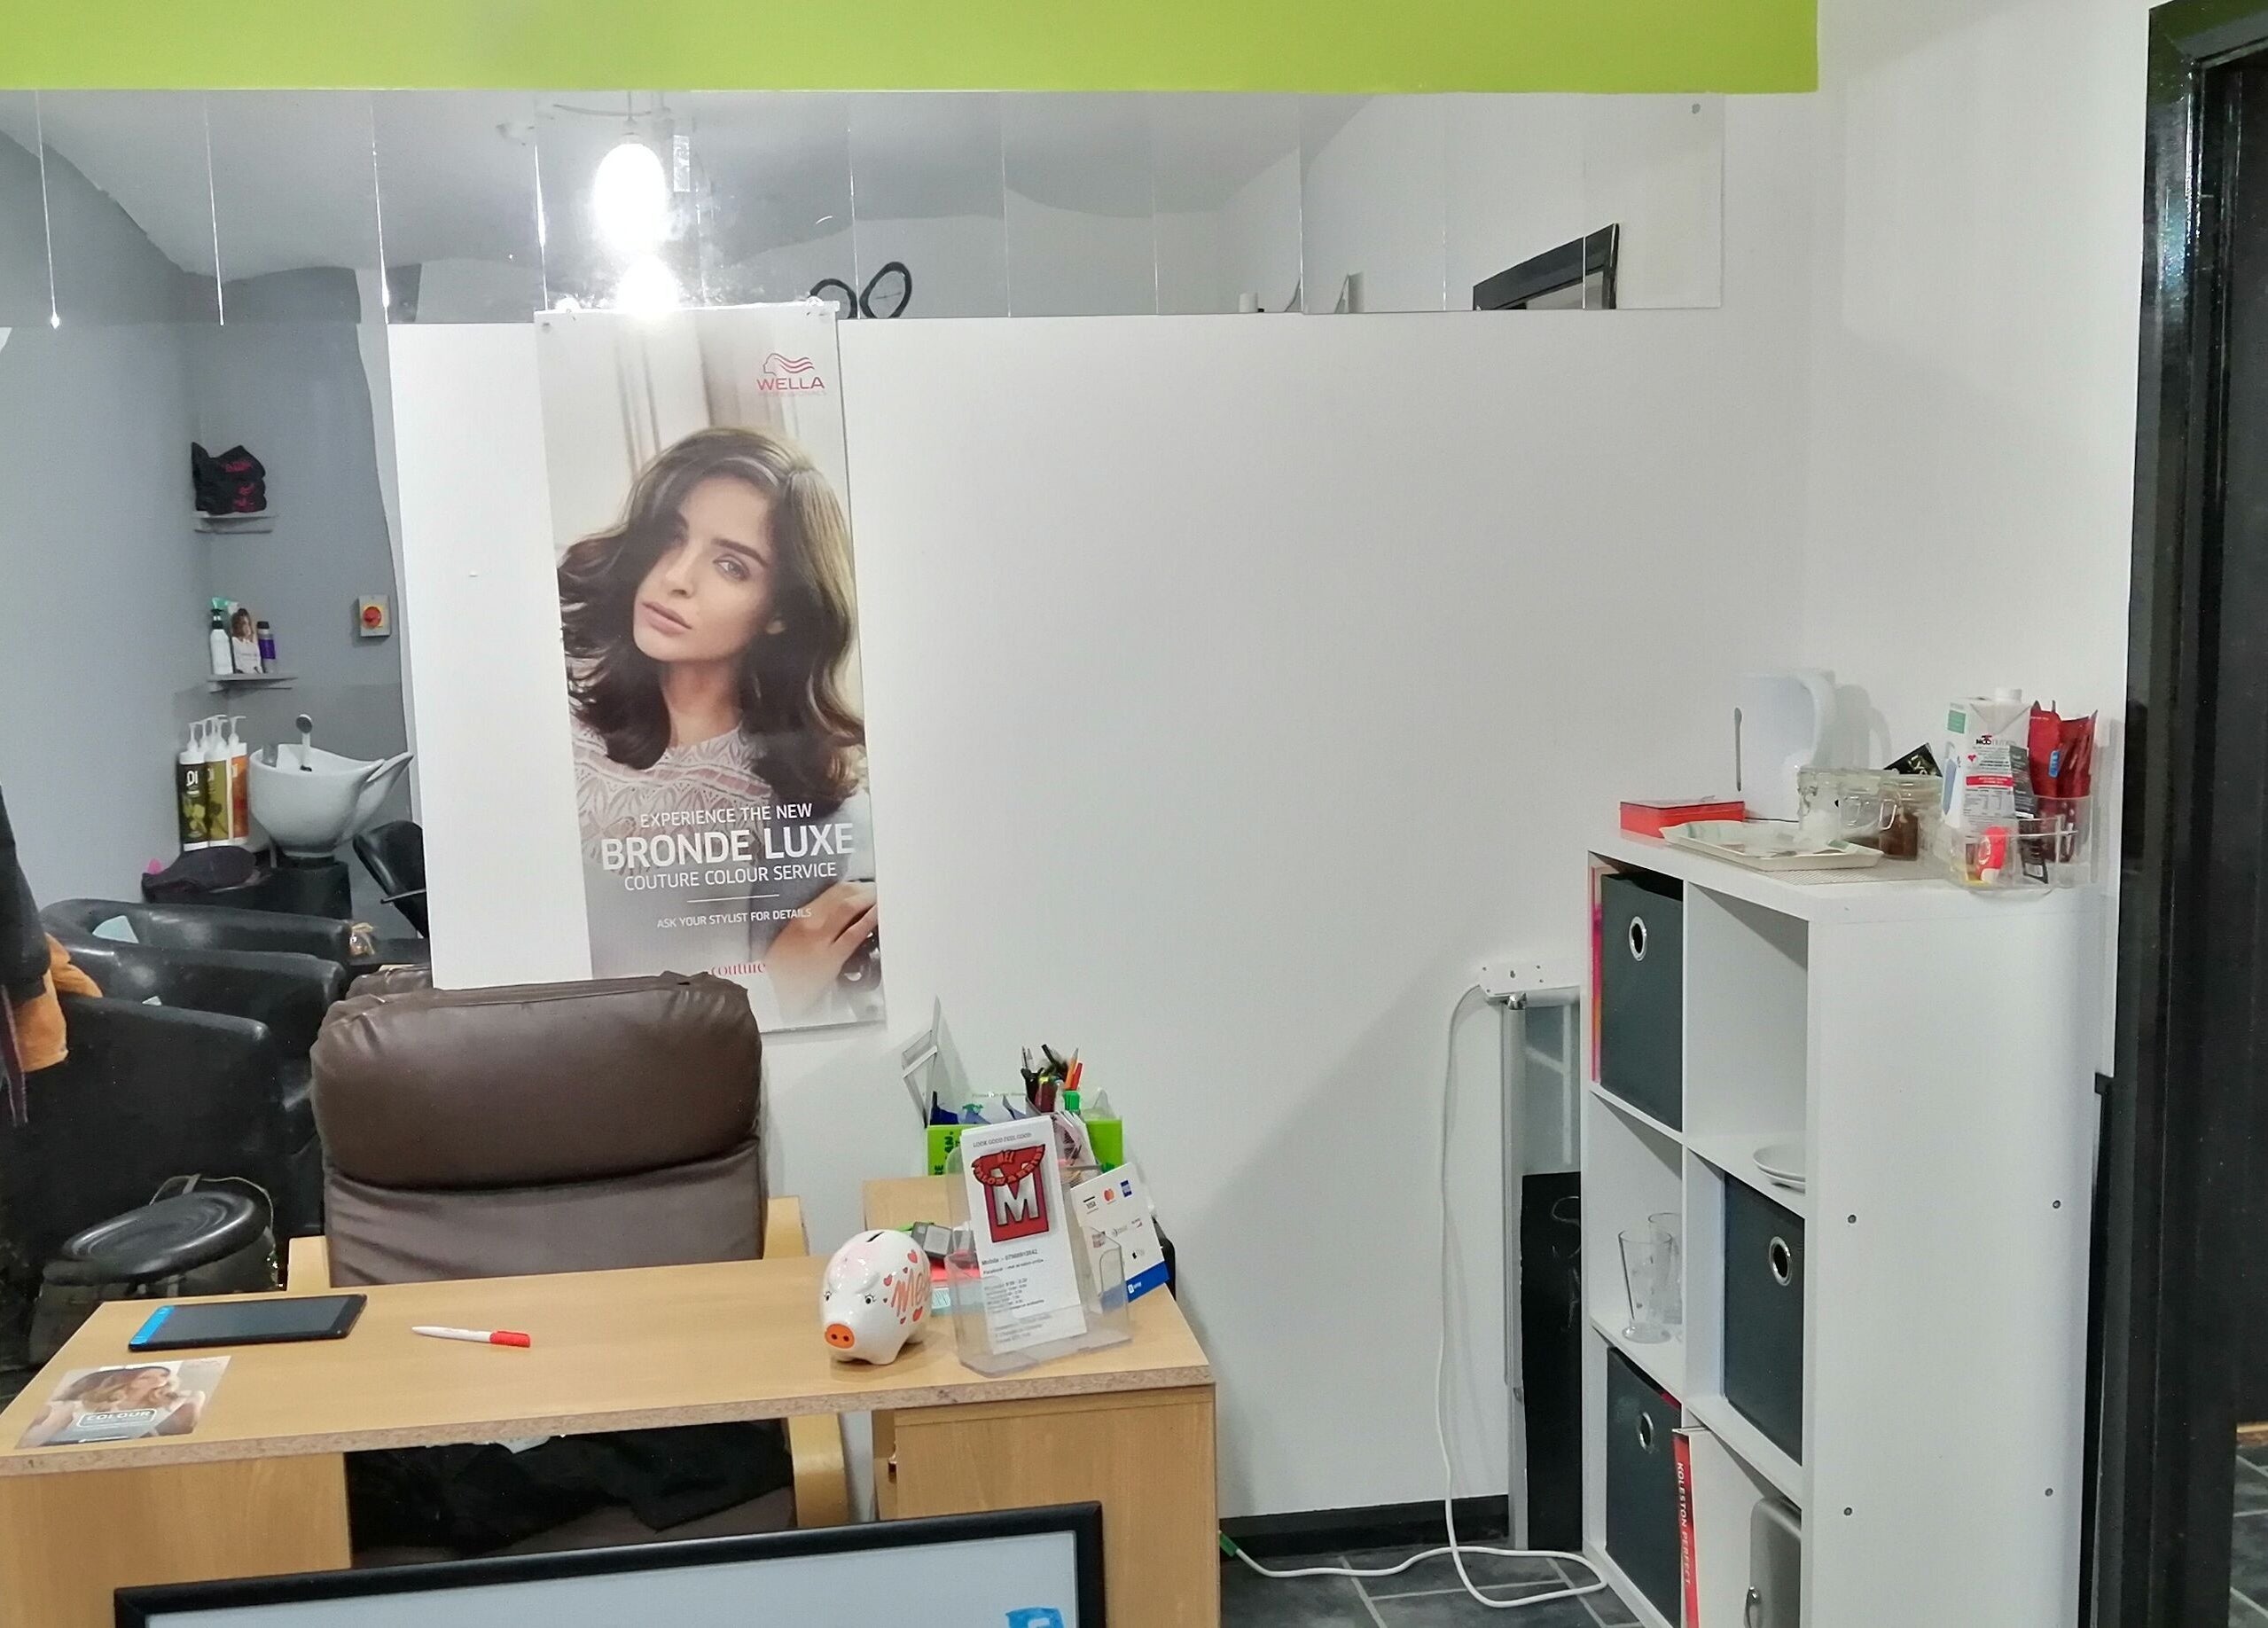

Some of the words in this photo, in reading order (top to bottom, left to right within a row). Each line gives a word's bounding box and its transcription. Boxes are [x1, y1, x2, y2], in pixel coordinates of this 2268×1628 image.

[756, 376, 825, 391] WELLA
[640, 808, 736, 828] EXPERIENCE
[740, 805, 772, 821] THE
[776, 802, 813, 819] NEW
[601, 829, 753, 871] BRONDE
[764, 822, 856, 860] LUXE
[624, 871, 700, 891] COUTURE
[704, 865, 770, 886] COLOUR
[773, 861, 838, 881] SERVICE
[657, 916, 676, 929] ASK
[679, 914, 708, 927] YOUR
[708, 912, 748, 925] STYLIST
[750, 910, 770, 922] FOR
[772, 907, 813, 920] DETAILS
[710, 962, 766, 977] couture
[86, 1411, 151, 1421] COLOUR
[1678, 1462, 1687, 1527] KOLESTON
[1681, 1530, 1691, 1585] PERFECT
